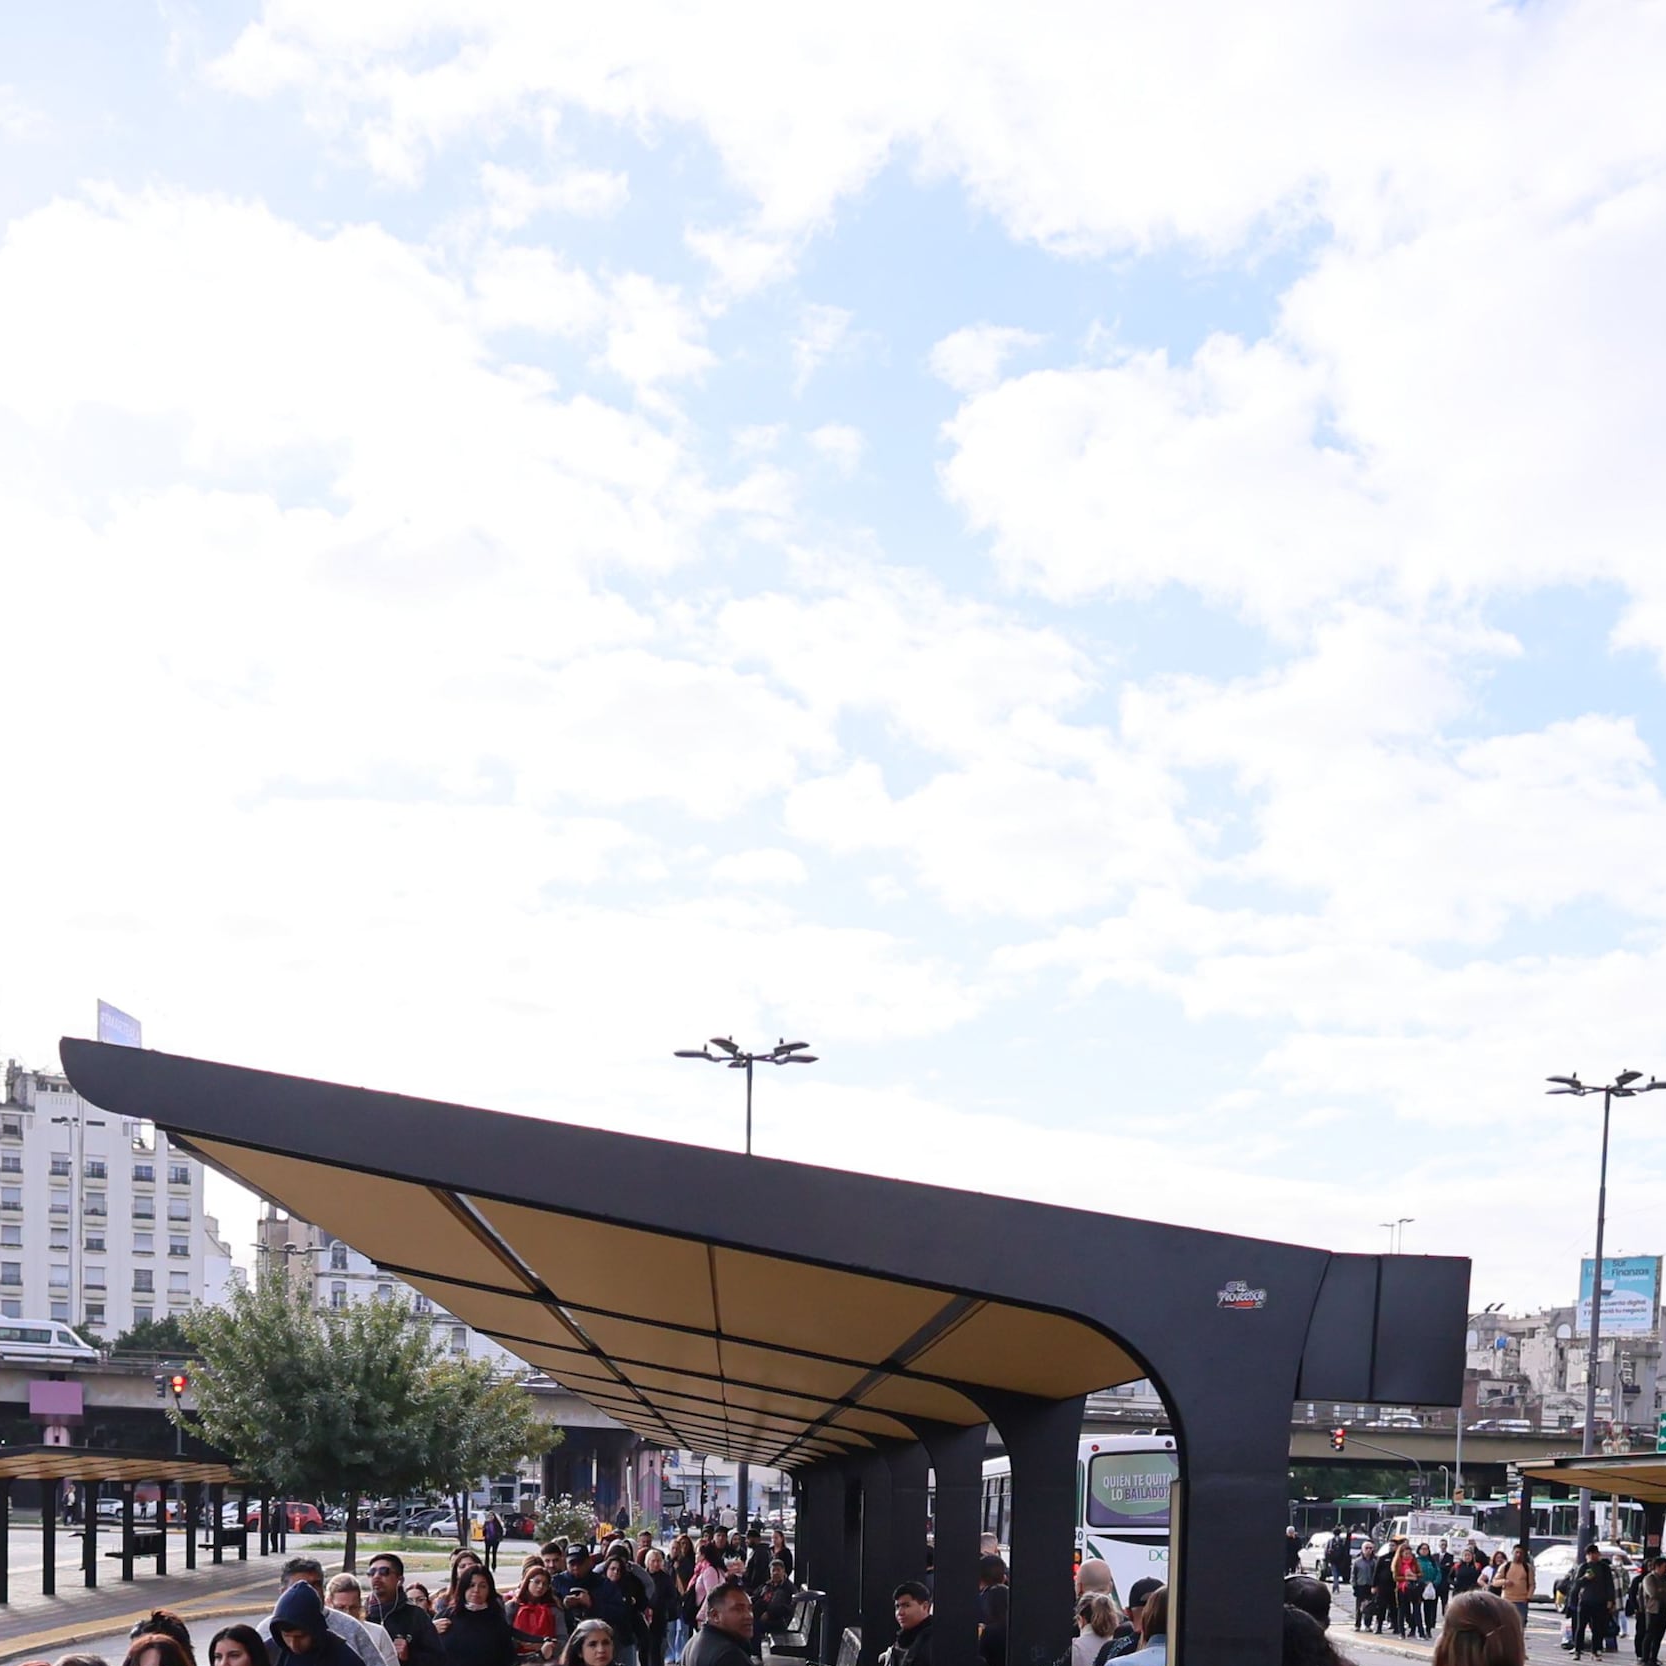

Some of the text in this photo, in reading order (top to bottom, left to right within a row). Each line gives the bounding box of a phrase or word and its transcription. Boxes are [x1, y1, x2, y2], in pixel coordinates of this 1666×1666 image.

[1612, 1268, 1649, 1276] Finanzas
[1133, 1474, 1144, 1486] TE
[1111, 1488, 1123, 1501] LO
